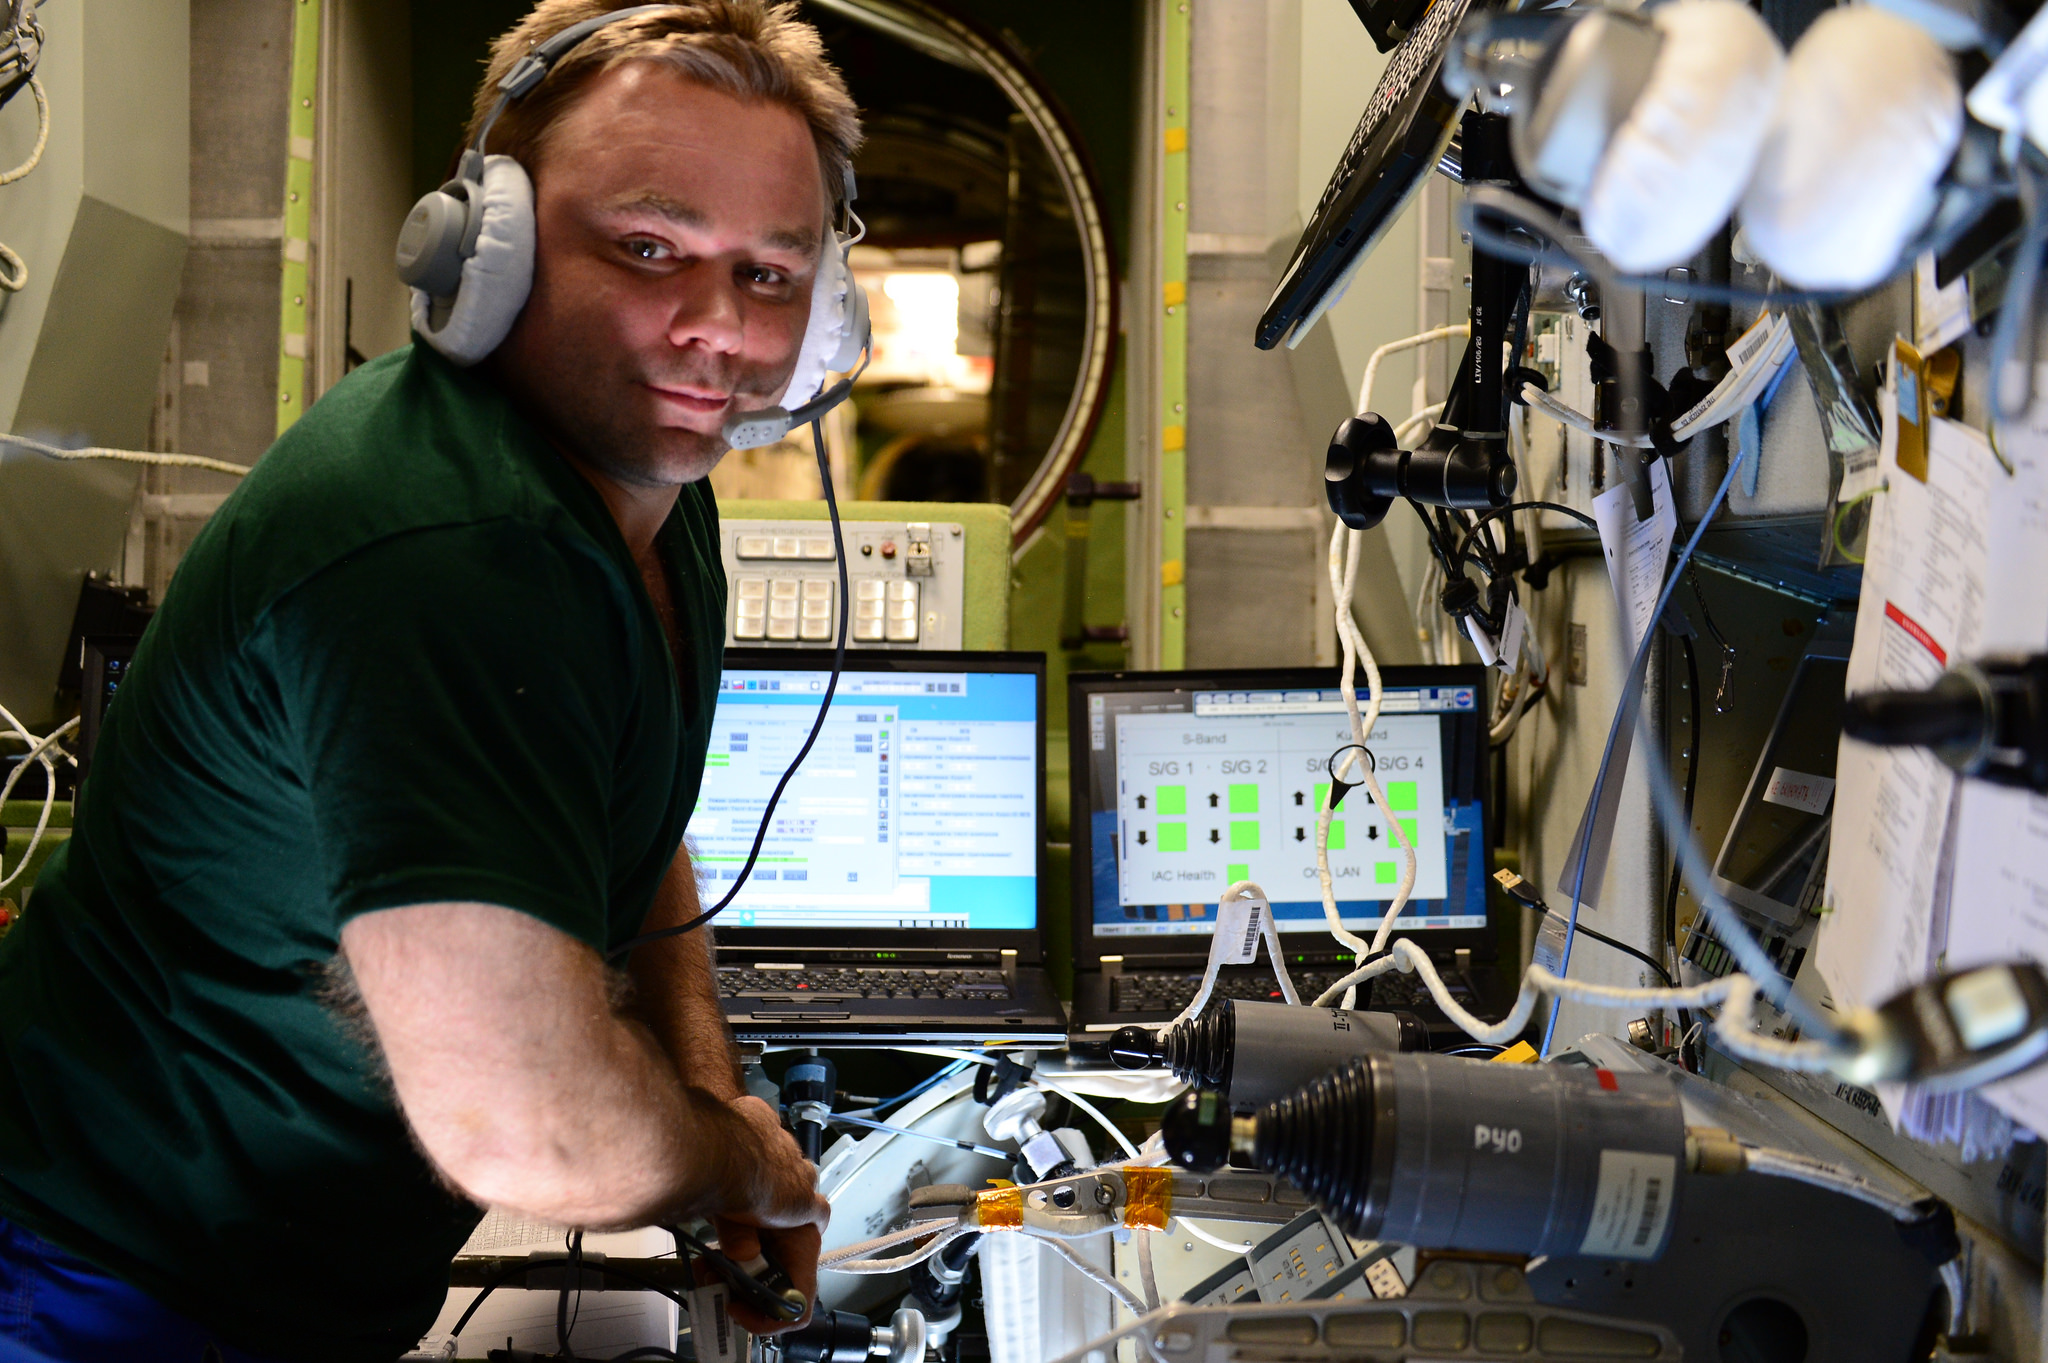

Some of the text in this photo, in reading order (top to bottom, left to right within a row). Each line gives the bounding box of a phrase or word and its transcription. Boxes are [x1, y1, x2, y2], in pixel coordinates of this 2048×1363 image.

[1182, 733, 1227, 744] S-Band
[1148, 761, 1194, 775] S/G 1
[1221, 759, 1268, 774] S/G 2
[1378, 756, 1424, 771] S/G 4
[1177, 870, 1216, 881] Health
[1335, 866, 1361, 877] LAN
